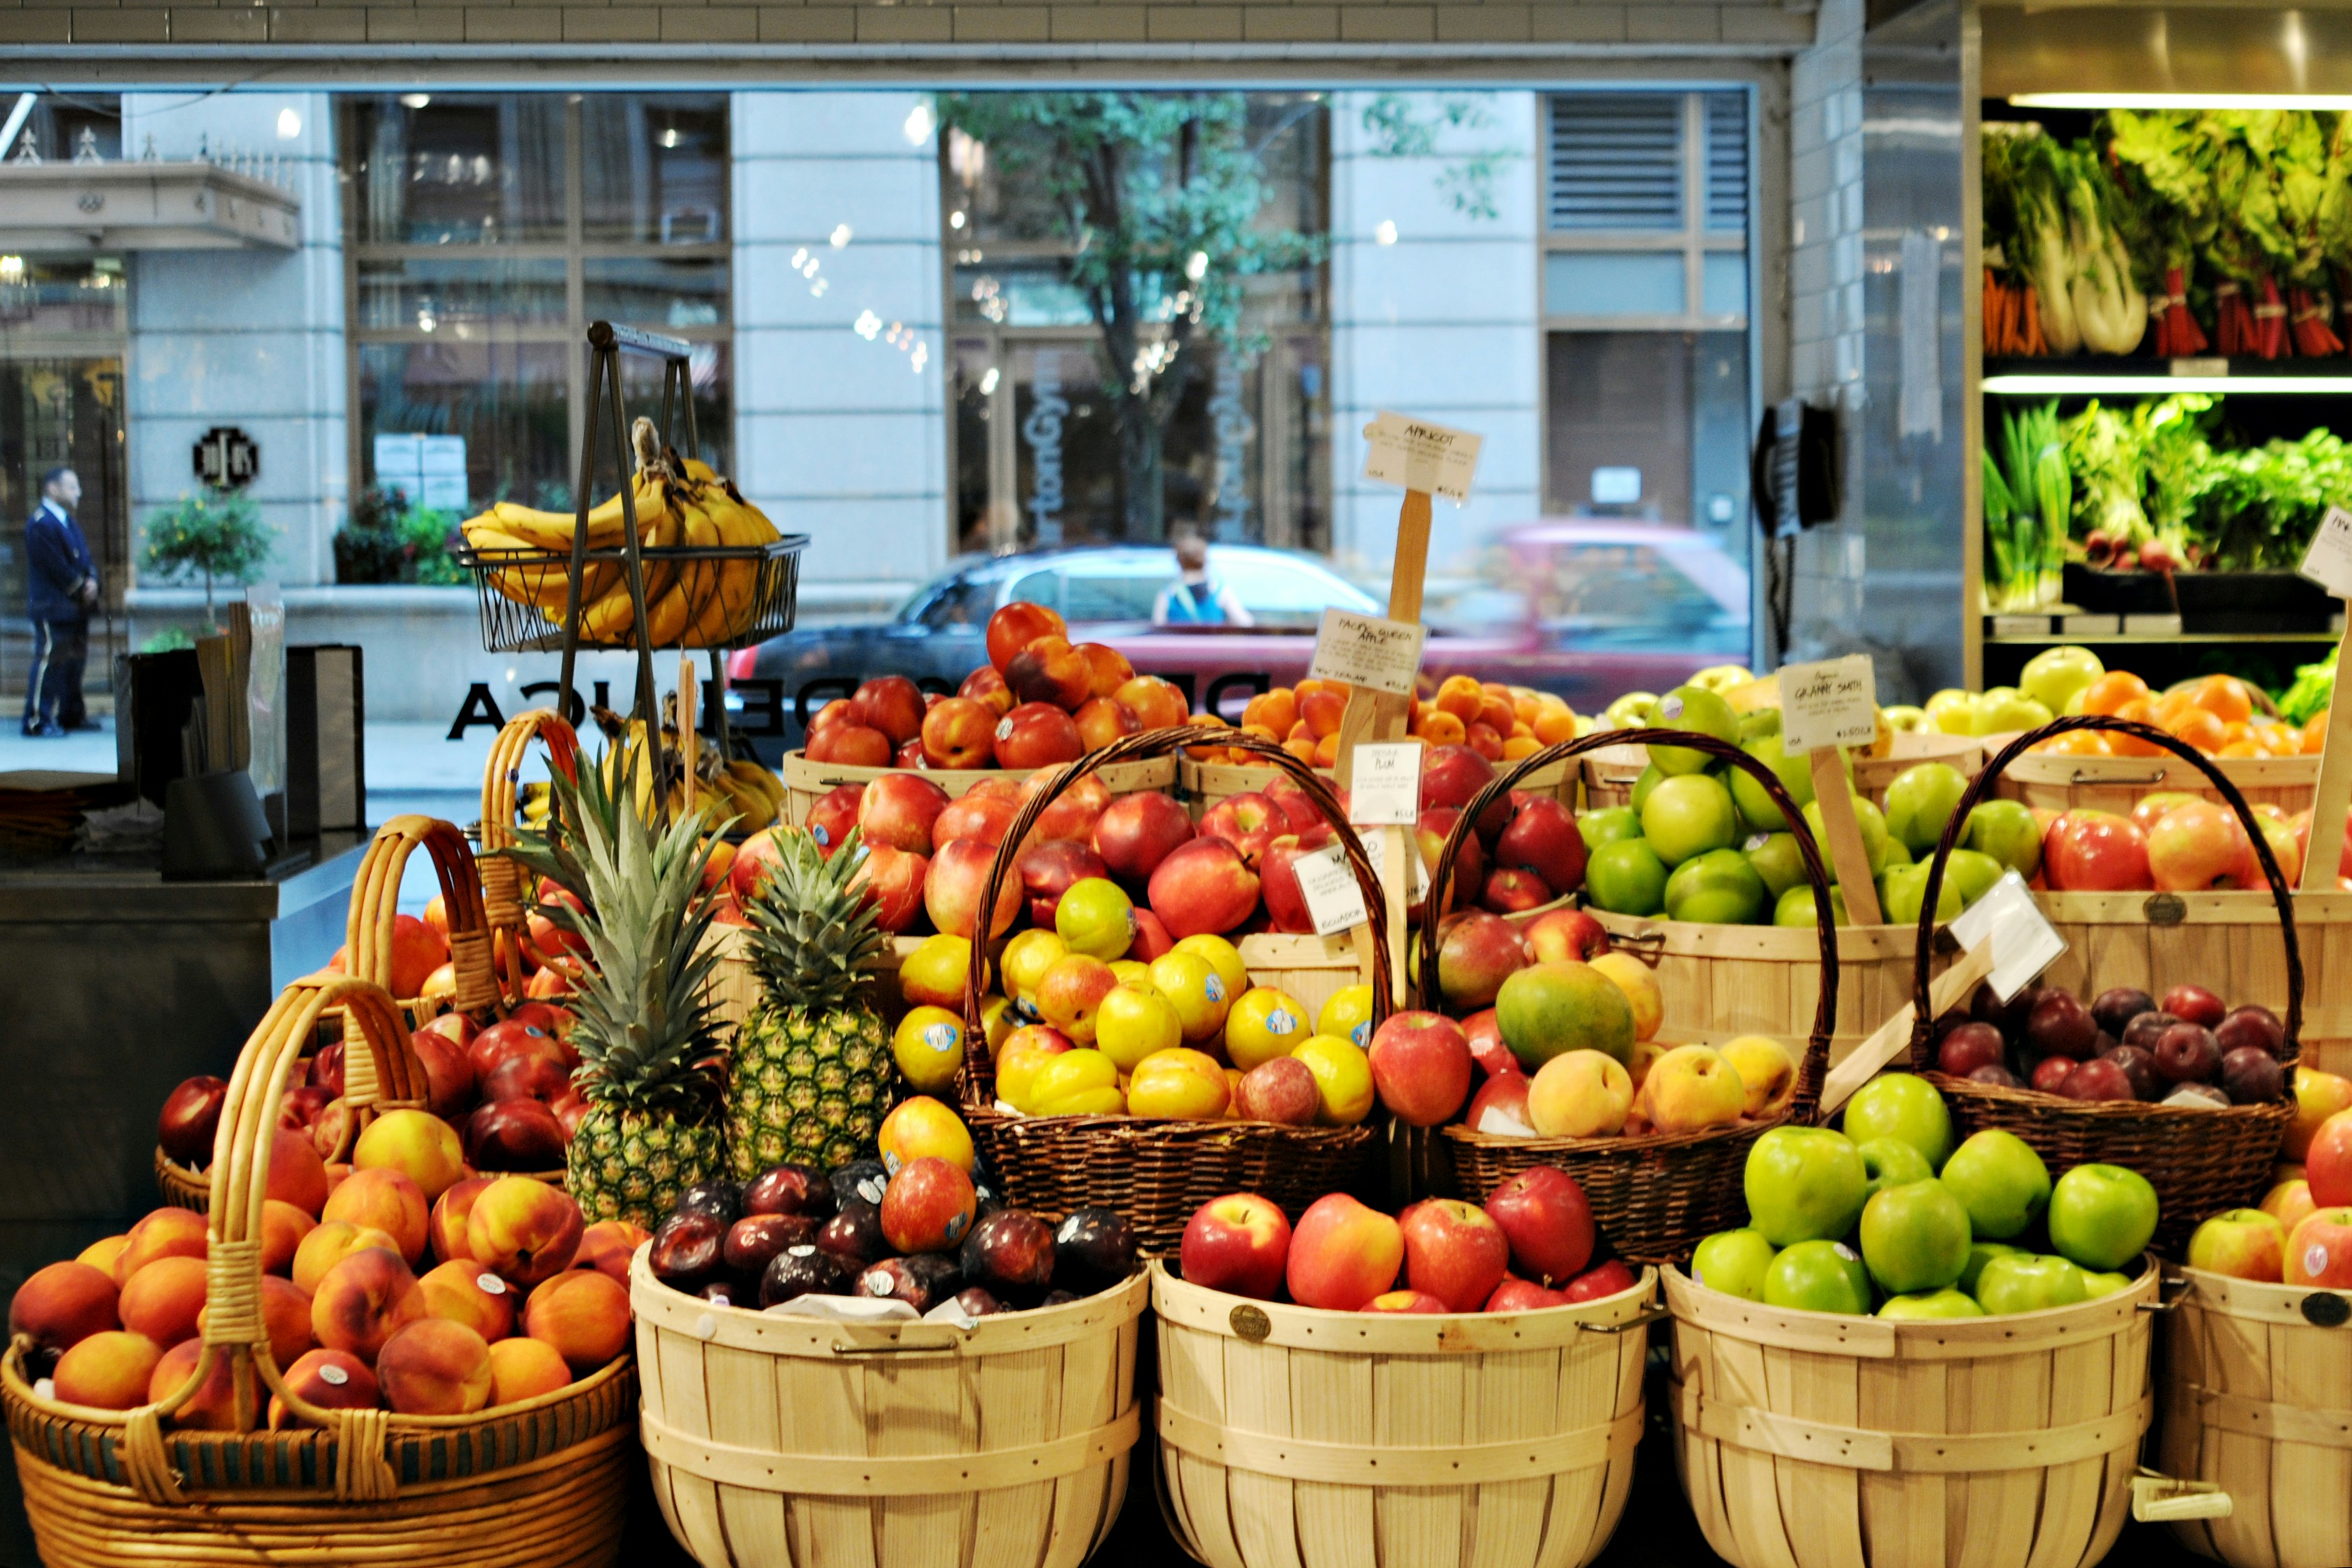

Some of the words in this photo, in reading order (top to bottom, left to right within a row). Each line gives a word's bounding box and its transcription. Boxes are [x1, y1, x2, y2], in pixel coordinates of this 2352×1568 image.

[1404, 424, 1457, 447] APRICOT
[1795, 682, 1833, 701] GRANNY
[1837, 678, 1863, 694] SMITH
[1321, 907, 1363, 929] ECUADOR
